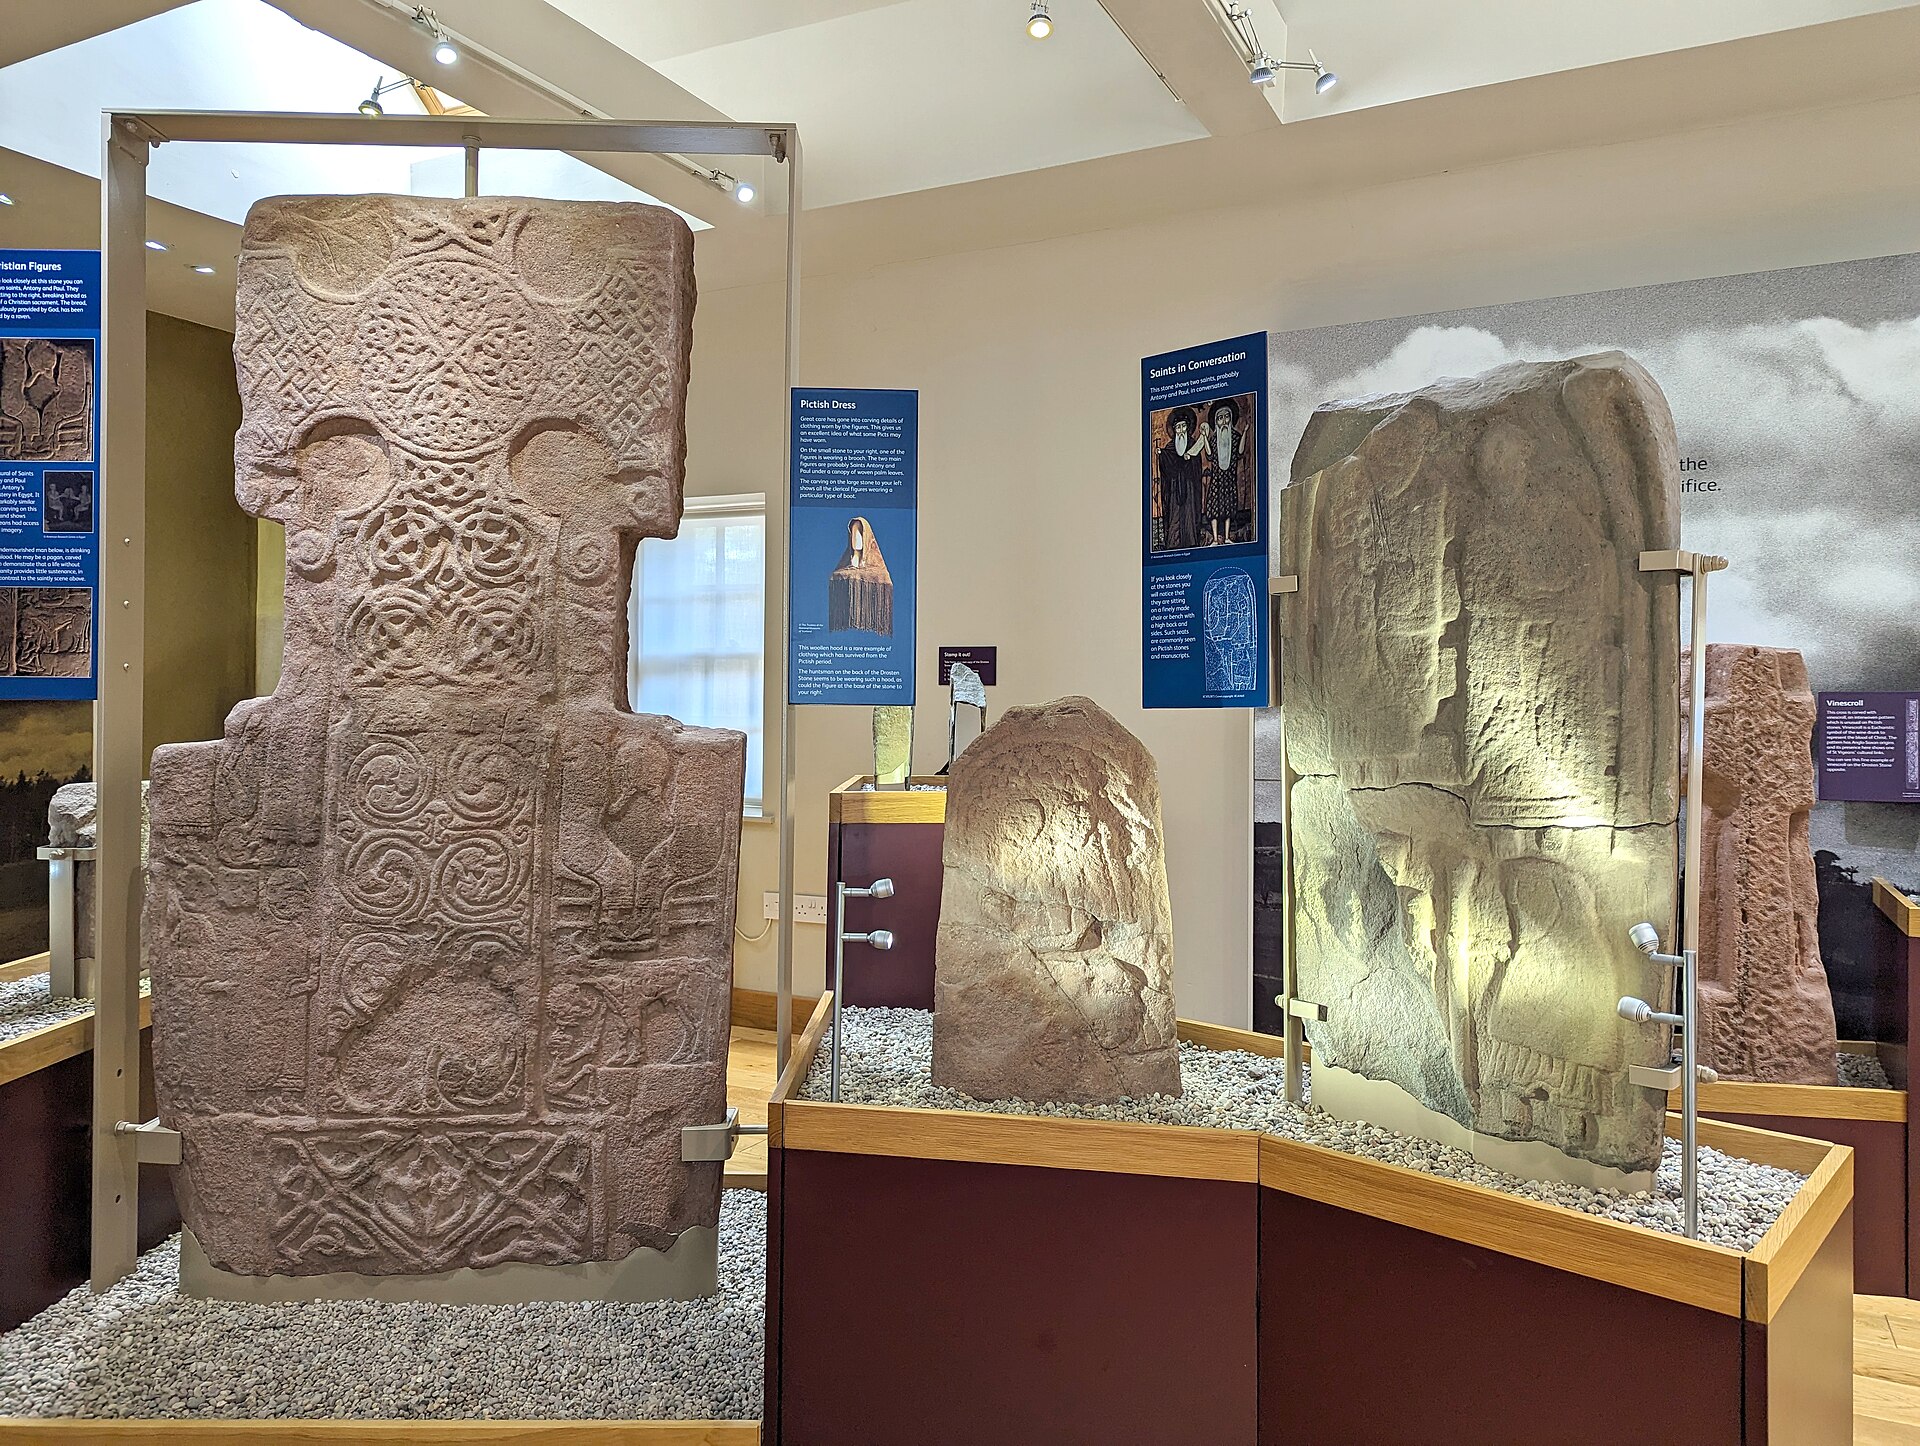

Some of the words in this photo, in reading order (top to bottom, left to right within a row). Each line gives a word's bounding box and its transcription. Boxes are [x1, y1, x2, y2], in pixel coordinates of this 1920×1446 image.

[29, 262, 61, 272] Figures
[1150, 367, 1176, 378] Saints
[1178, 364, 1186, 372] in
[1188, 351, 1246, 370] Conversation
[800, 400, 829, 408] Pictish
[832, 400, 856, 409] Dress
[1679, 457, 1707, 471] the
